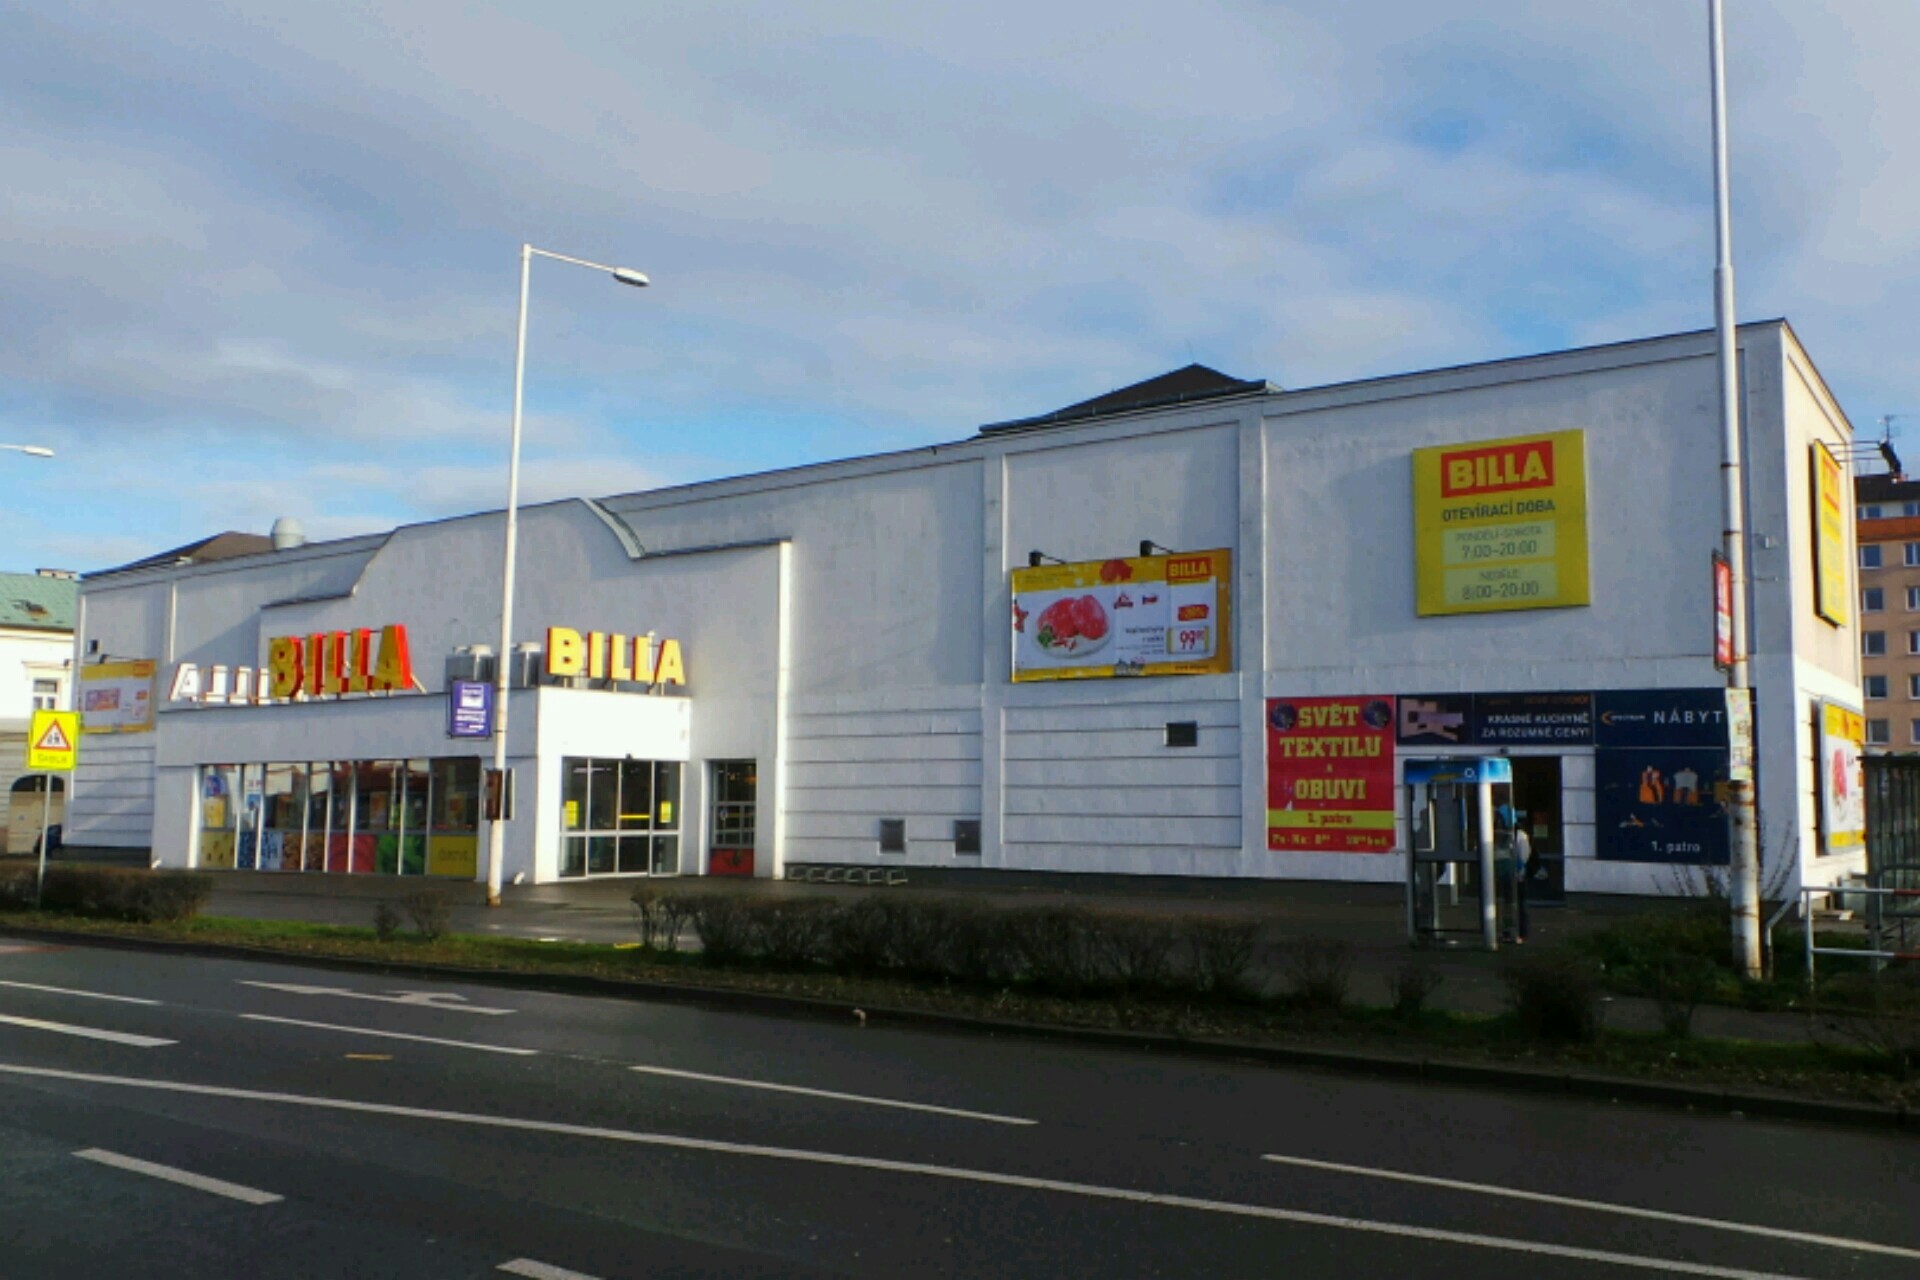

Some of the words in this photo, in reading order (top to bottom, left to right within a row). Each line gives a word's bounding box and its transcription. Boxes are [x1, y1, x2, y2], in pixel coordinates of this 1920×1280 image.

[1448, 451, 1549, 491] BILLA
[1442, 498, 1513, 522] OTEVÍRACÍ
[1516, 499, 1556, 514] DOBA
[1169, 561, 1208, 577] BILLA
[268, 624, 413, 698] BILLA
[545, 627, 686, 685] BILLA
[1298, 703, 1359, 727] SVĚT
[1653, 705, 1723, 724] NÁBYT
[1481, 727, 1496, 738] ZA
[1280, 735, 1381, 757] TEXTILU
[1294, 779, 1367, 800] OBUVI
[1665, 841, 1701, 856] patro
